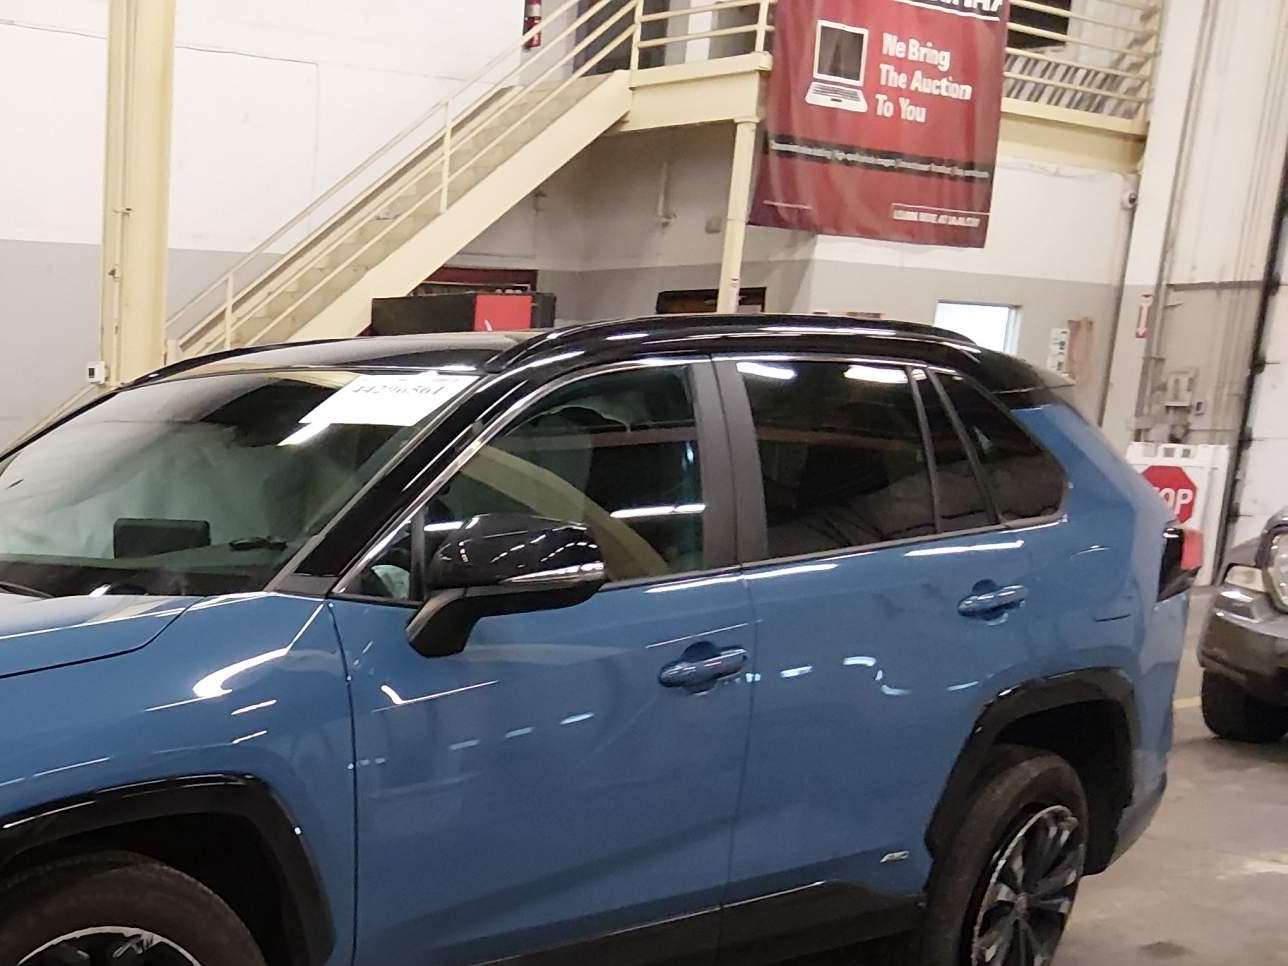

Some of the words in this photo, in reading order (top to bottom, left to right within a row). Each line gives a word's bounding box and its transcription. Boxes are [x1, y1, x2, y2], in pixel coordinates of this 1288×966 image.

[882, 32, 906, 58] We
[907, 38, 951, 71] Bring
[879, 63, 907, 89] The
[910, 70, 972, 100] Auction
[875, 93, 894, 118] To
[898, 96, 927, 122] You
[1154, 486, 1193, 515] OP
